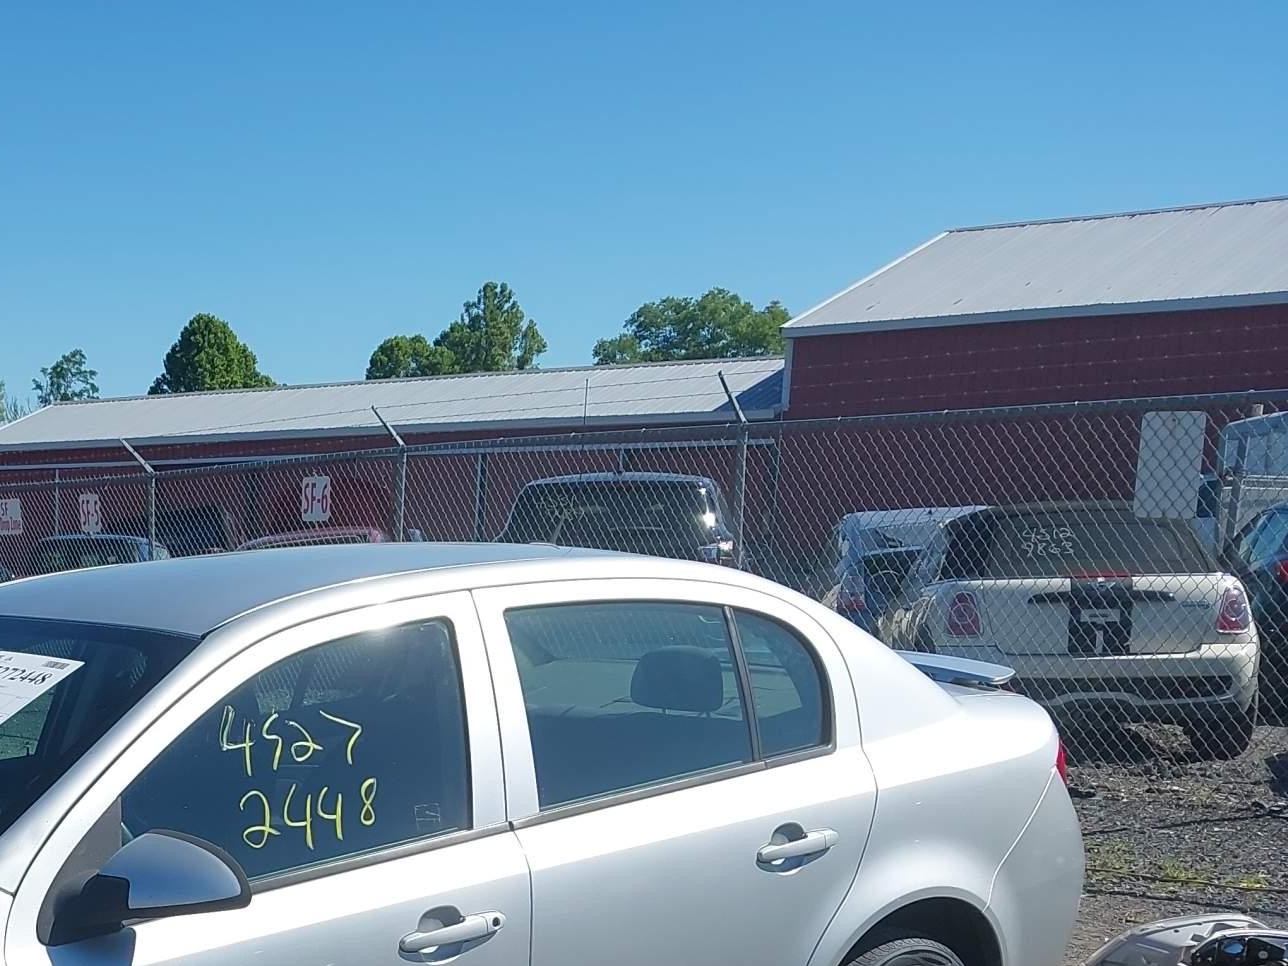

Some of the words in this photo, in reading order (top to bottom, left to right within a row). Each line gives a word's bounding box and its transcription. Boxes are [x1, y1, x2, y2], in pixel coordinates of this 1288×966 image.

[0, 502, 9, 516] SF
[81, 500, 100, 526] SF-5
[303, 482, 328, 514] SF-6
[219, 704, 363, 777] 4527
[239, 777, 377, 850] 2448
